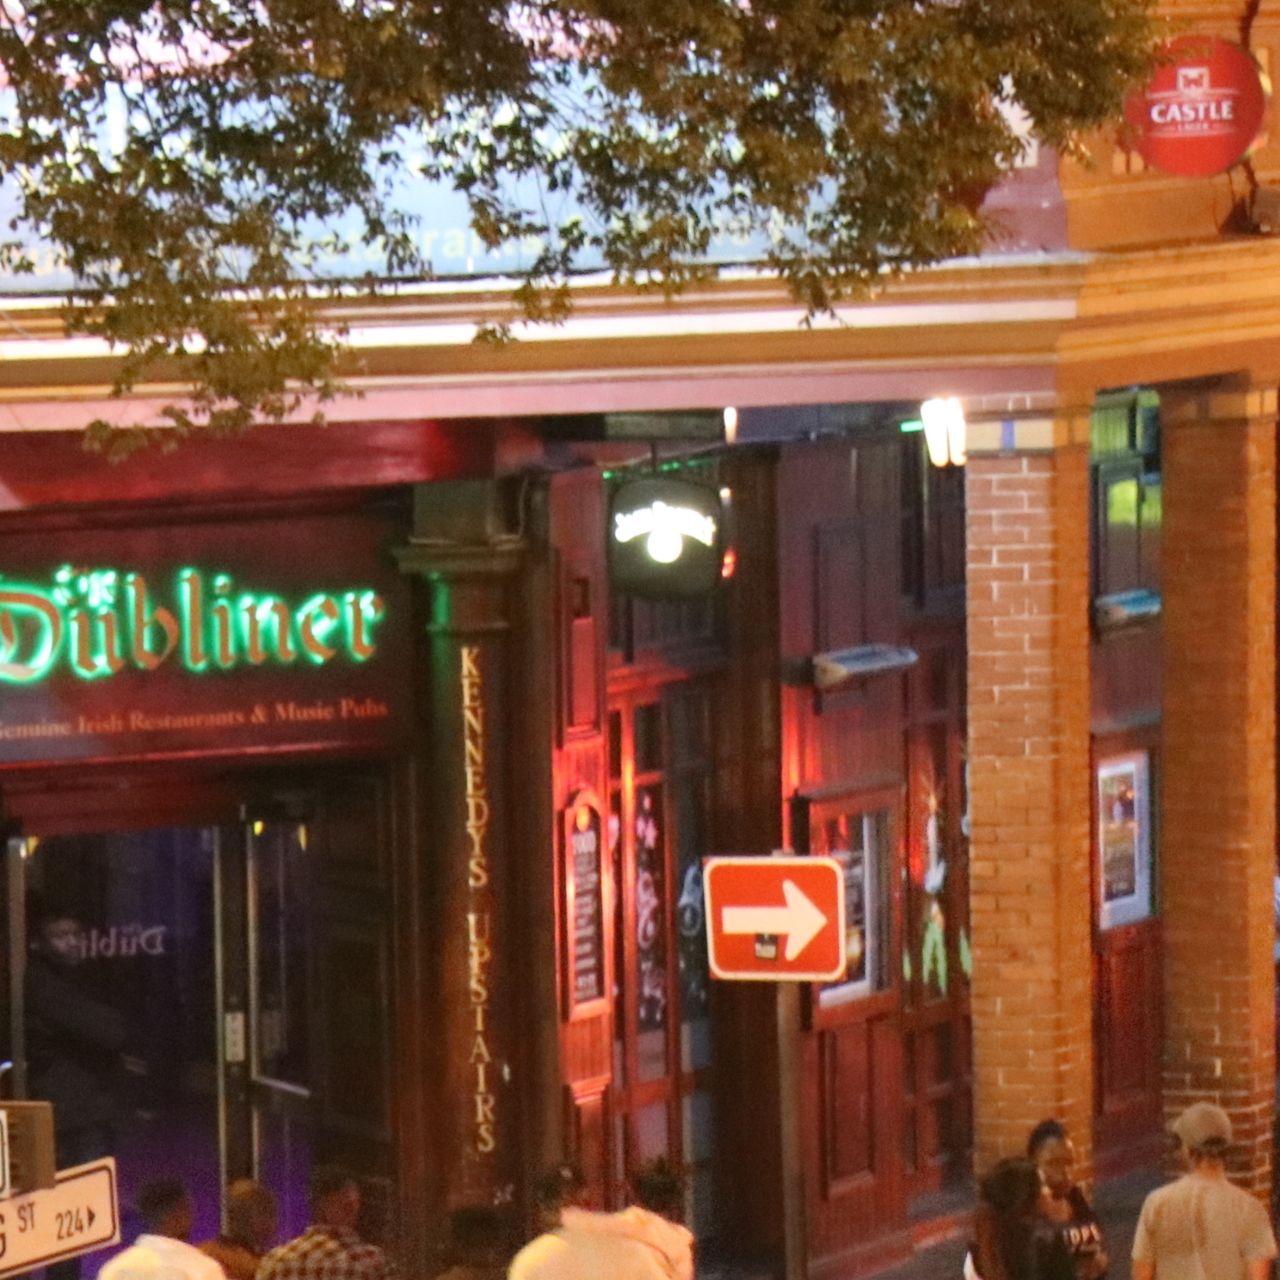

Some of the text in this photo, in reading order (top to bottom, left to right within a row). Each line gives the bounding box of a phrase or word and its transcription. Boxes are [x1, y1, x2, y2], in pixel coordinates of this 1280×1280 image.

[1151, 99, 1233, 123] CASTLE
[78, 714, 123, 735] Irish
[129, 708, 242, 731] Restaurants
[250, 703, 268, 723] &
[275, 700, 335, 721] Music
[341, 697, 389, 718] Pubs
[466, 912, 496, 1152] UPSTAIRS
[17, 1201, 37, 1234] ST
[54, 1212, 85, 1242] 224
